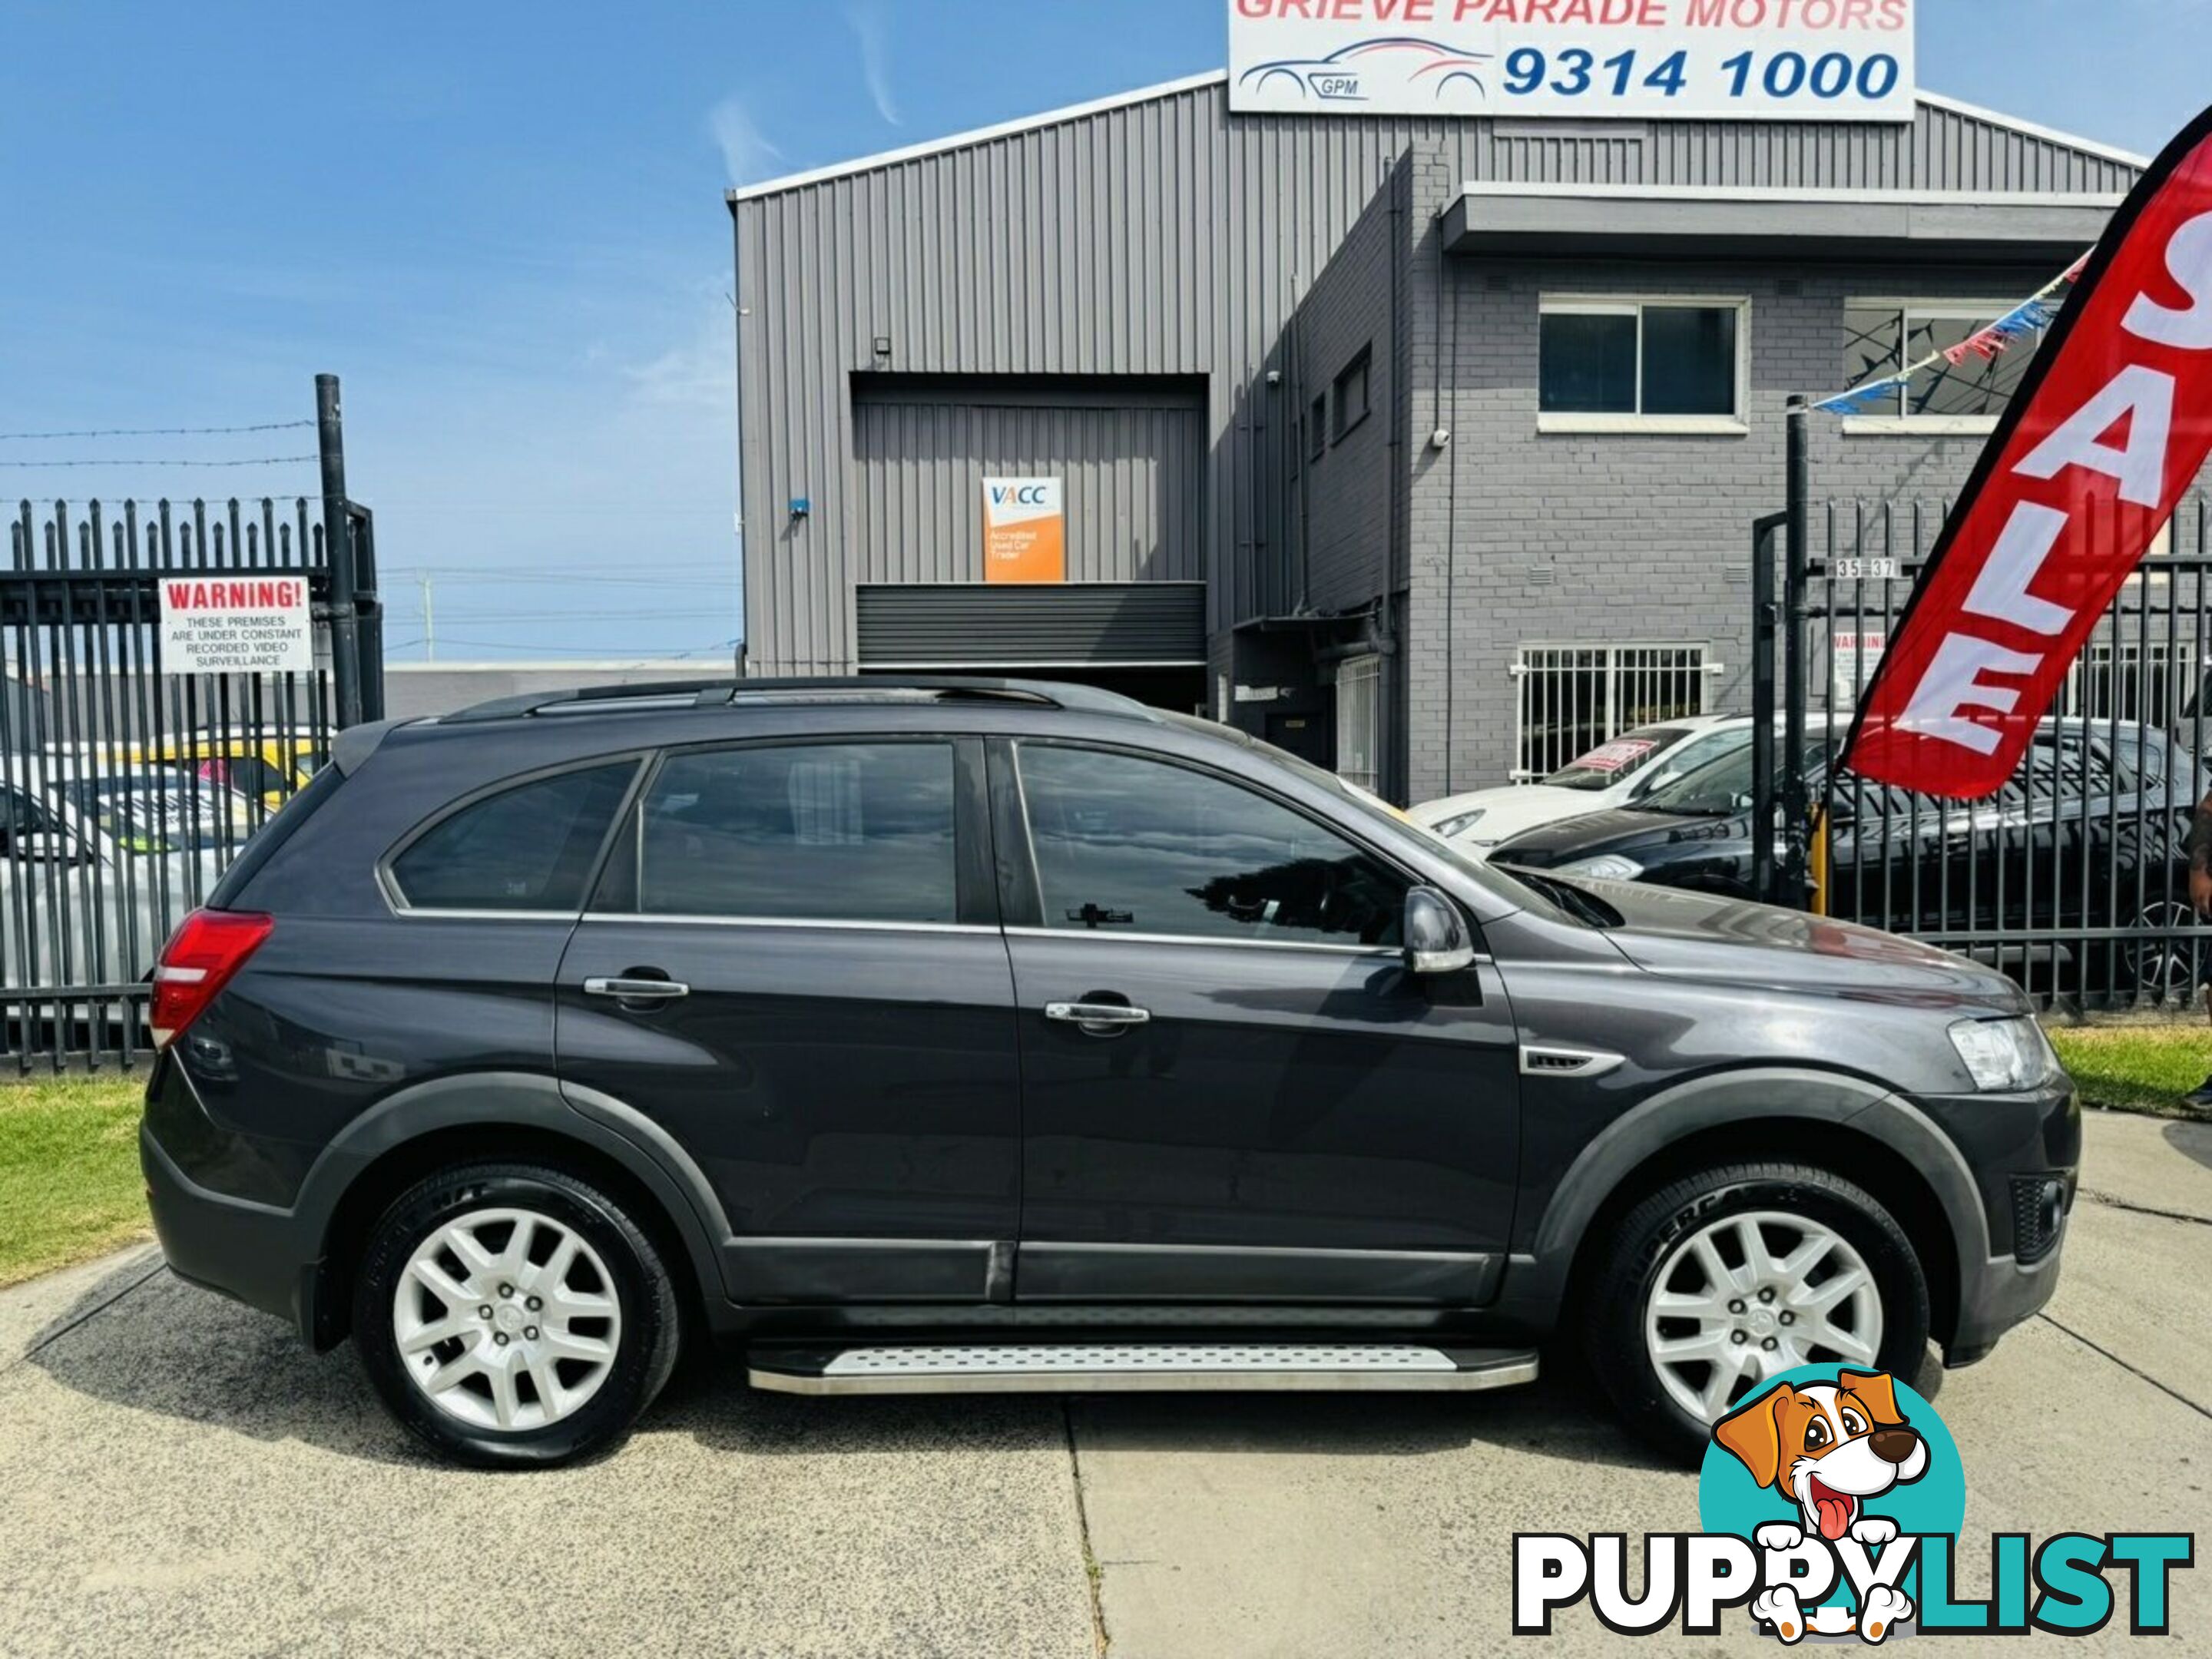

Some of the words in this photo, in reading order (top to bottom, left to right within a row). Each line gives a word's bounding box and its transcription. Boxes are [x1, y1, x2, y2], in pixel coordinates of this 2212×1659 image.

[1236, 0, 1435, 22] GRIEVE
[1452, 0, 1667, 26] PARADE
[1686, 0, 1906, 31] MOTORS
[1503, 47, 1687, 97] 9314
[1720, 50, 1899, 99] 1000
[1321, 79, 1359, 94] GPM
[1896, 210, 2212, 757] SALE
[992, 486, 1047, 505] VACC
[167, 581, 302, 609] WARNING!
[186, 618, 223, 628] THESE
[227, 617, 286, 627] PREMISES
[171, 631, 194, 641] ARE
[198, 631, 237, 641] UNDER
[242, 629, 302, 639] CONSTANT
[187, 643, 250, 654] RECORDED
[253, 642, 289, 652] VIDEO
[197, 656, 281, 667] SURVEILLANCE
